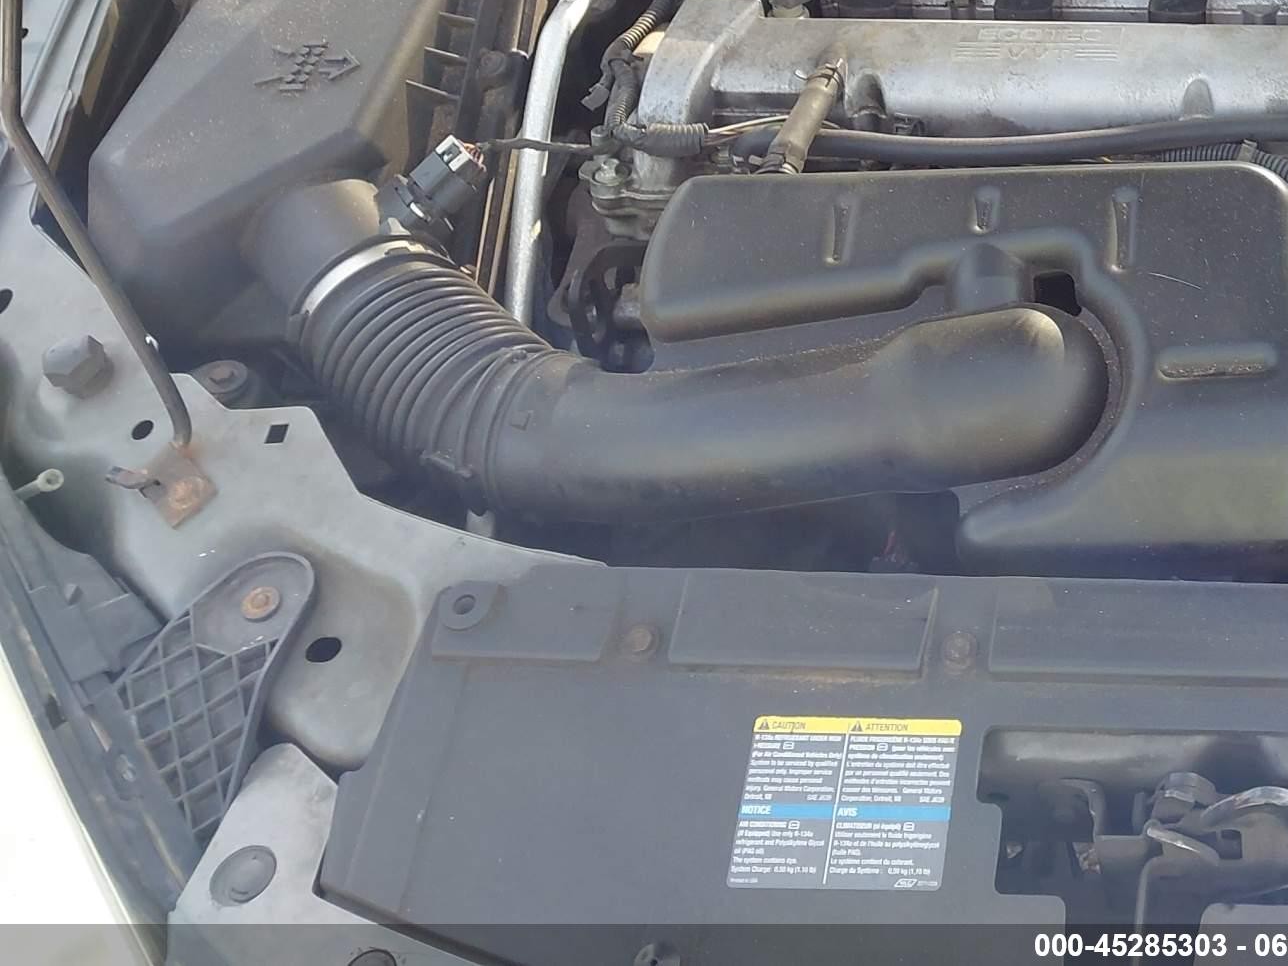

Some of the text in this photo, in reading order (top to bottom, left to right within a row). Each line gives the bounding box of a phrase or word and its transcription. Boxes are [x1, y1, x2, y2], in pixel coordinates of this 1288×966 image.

[978, 28, 1102, 41] ECOTEC
[1008, 47, 1070, 60] VVT
[741, 805, 772, 814] NOTICE
[838, 808, 858, 816] AVIS
